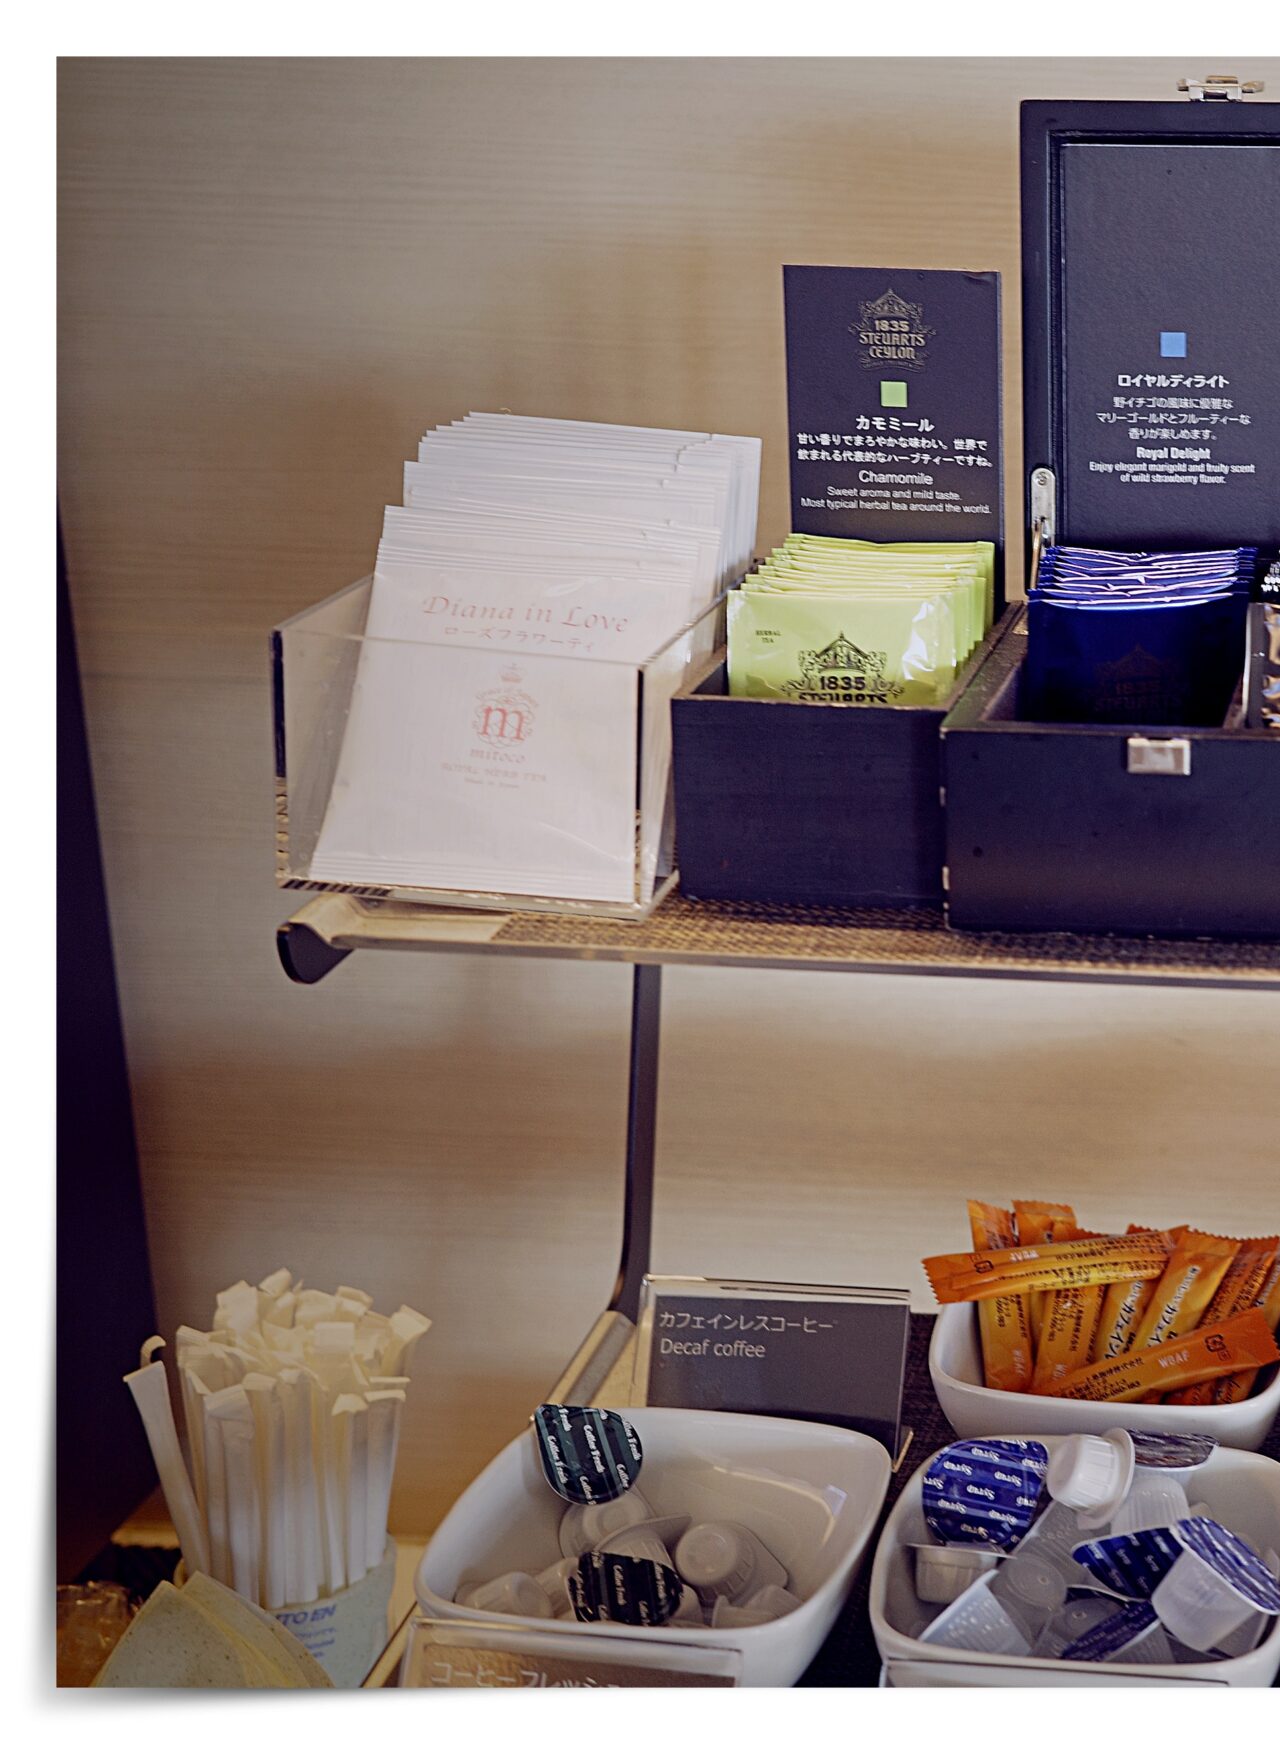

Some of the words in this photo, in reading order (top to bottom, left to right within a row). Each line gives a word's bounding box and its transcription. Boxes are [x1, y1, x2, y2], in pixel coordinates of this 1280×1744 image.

[875, 320, 910, 331] 1835
[859, 332, 925, 346] STEUARTS
[869, 347, 916, 360] CEYLON
[1118, 374, 1229, 388] ロイヤルディライト
[856, 415, 935, 431] カモミール
[1137, 447, 1168, 460] Royal
[1170, 447, 1210, 461] Delight
[1089, 462, 1113, 472] Enjoy
[1115, 462, 1147, 473] elegant
[1149, 462, 1186, 473] marigold
[1188, 463, 1205, 472] and
[1230, 464, 1255, 473] scent
[859, 471, 934, 485] Chamomile
[1120, 474, 1130, 482] of
[1132, 474, 1150, 482] wild
[1151, 475, 1198, 485] strawberry
[827, 487, 858, 497] Sweet
[859, 489, 890, 498] aroma
[892, 489, 911, 498] and
[913, 489, 933, 499] mild
[935, 491, 962, 500] taste.
[801, 498, 825, 508] Most
[827, 499, 858, 510] typical
[859, 500, 890, 510] herbal
[892, 501, 908, 511] tea
[910, 502, 943, 512] around
[945, 503, 961, 512] the
[963, 504, 991, 514] world.
[423, 596, 515, 621] Diana
[524, 603, 552, 623] in
[560, 606, 628, 633] Love
[820, 676, 866, 691] 1835
[659, 1311, 834, 1334] カフェインレスコーヒー
[660, 1338, 710, 1356] Decaf
[714, 1341, 766, 1358] coffee
